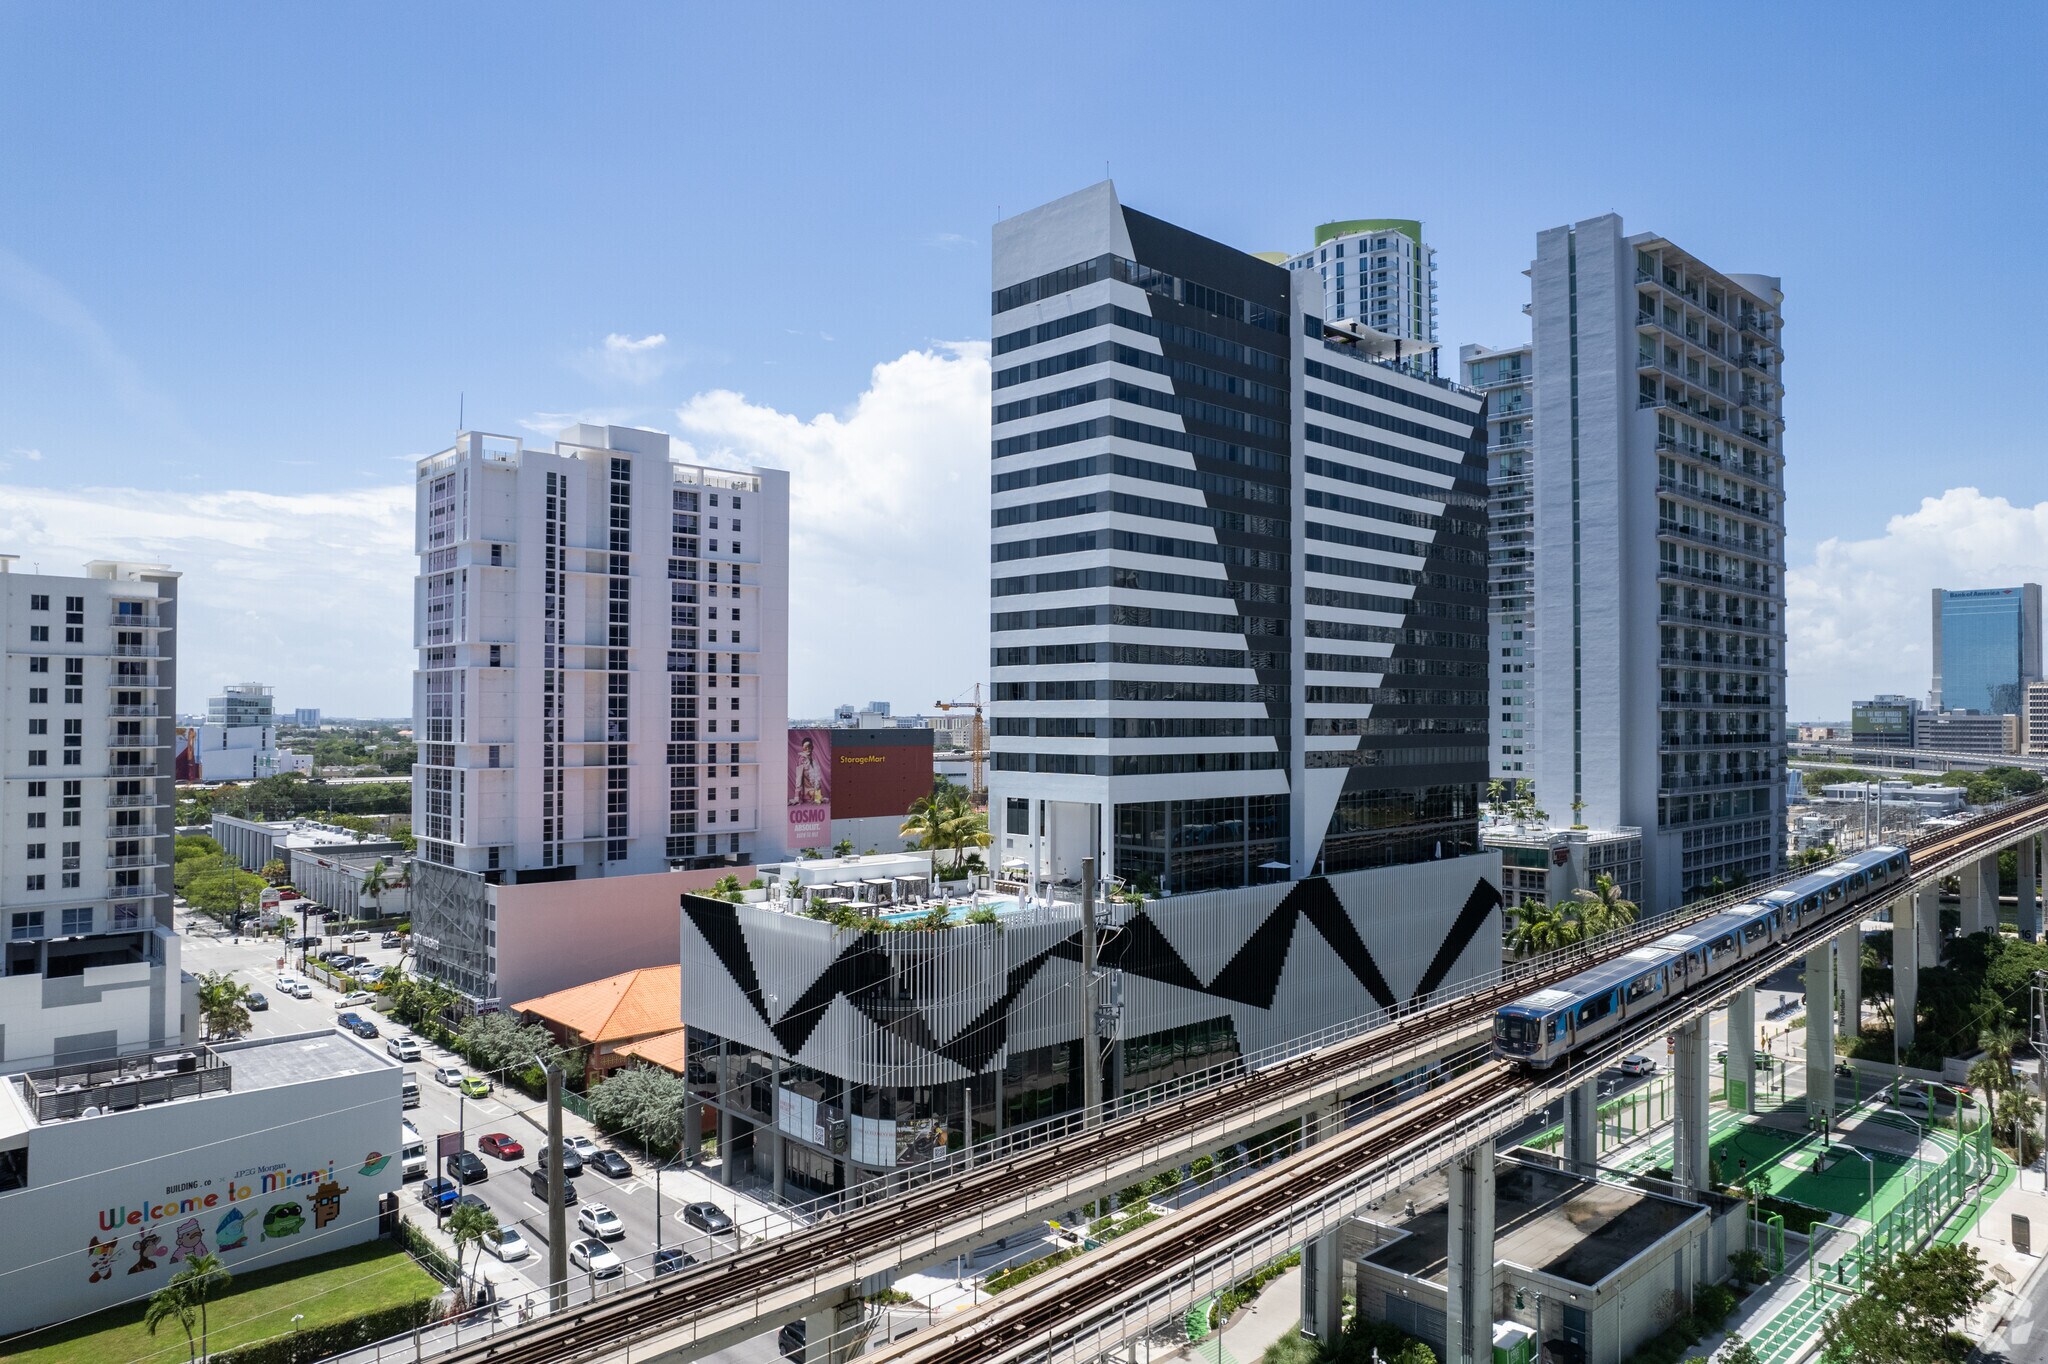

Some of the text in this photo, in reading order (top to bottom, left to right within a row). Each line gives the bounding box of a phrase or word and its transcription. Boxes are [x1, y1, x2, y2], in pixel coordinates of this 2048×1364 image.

[840, 755, 886, 765] StorageMart
[790, 809, 825, 823] COSMO
[2021, 930, 2032, 939] 16
[166, 1180, 198, 1195] BUILDING
[257, 1162, 287, 1174] Morgan
[99, 1193, 219, 1231] Welcome
[229, 1182, 252, 1201] to
